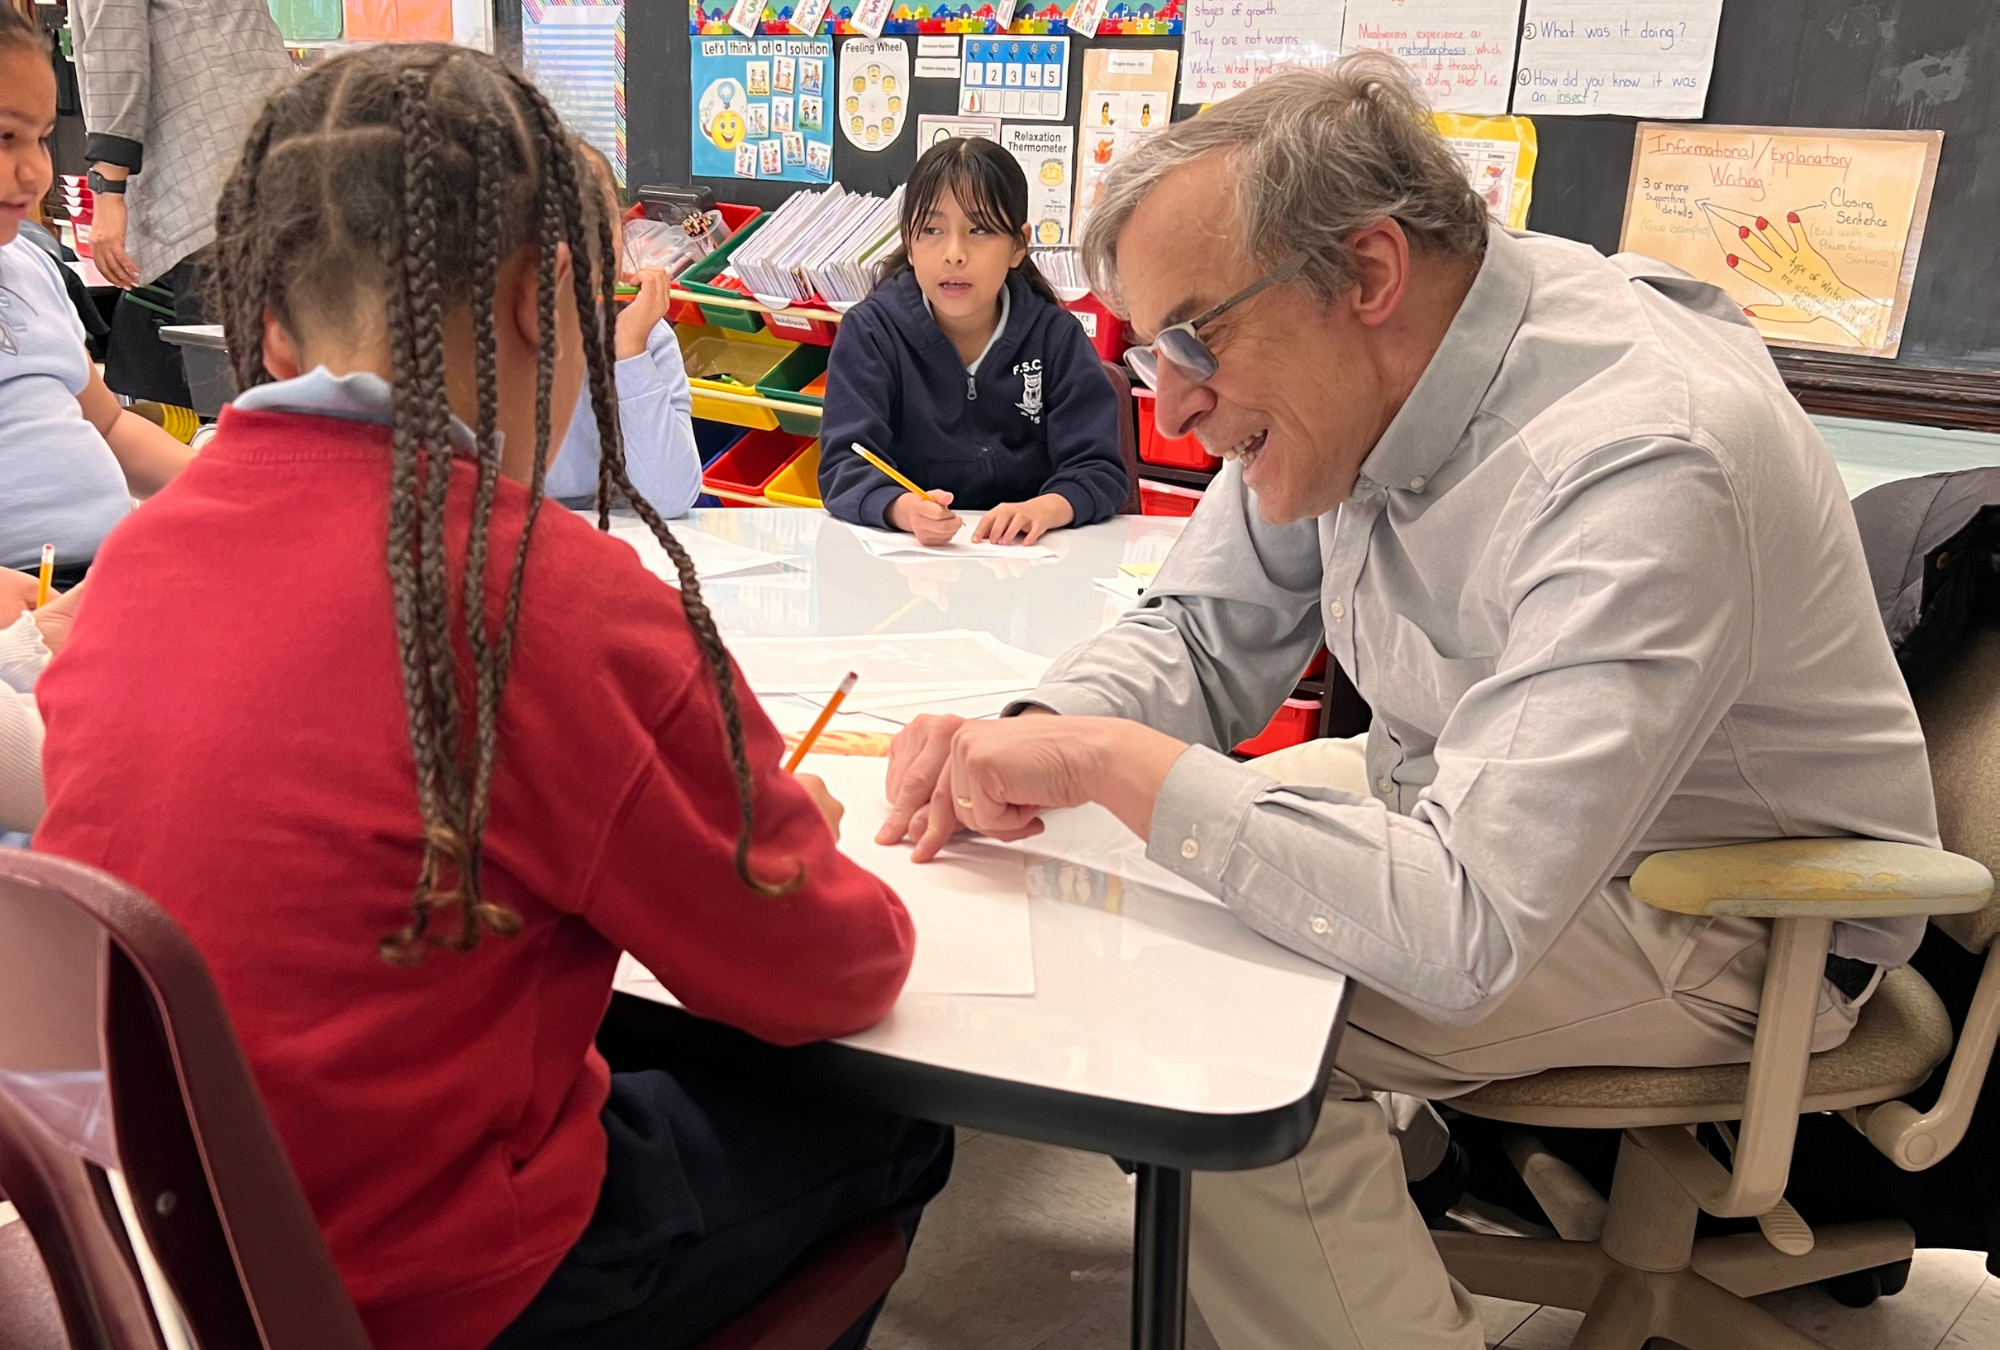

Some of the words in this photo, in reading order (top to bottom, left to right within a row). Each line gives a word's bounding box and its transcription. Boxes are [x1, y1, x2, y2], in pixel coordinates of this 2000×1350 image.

[1194, 1, 1224, 28] stages
[1232, 2, 1243, 16] of
[1358, 23, 1407, 39] Mealworms
[1416, 30, 1464, 50] experience
[1471, 30, 1481, 38] a
[1541, 20, 1575, 38] What
[1585, 27, 1610, 38] was
[1620, 20, 1630, 38] it
[704, 42, 724, 55] Let's
[730, 42, 753, 55] think
[762, 42, 771, 55] of
[775, 43, 782, 53] a
[790, 42, 829, 56] solution
[845, 42, 875, 55] Feeling
[877, 41, 902, 53] Wheel
[1190, 30, 1214, 59] They
[1222, 36, 1237, 46] are
[1245, 29, 1261, 44] not
[1190, 59, 1220, 74] Write:
[1224, 59, 1249, 74] What
[1433, 63, 1444, 80] go
[1448, 57, 1482, 81] through
[991, 69, 998, 82] 2
[1010, 70, 1017, 83] 3
[1030, 70, 1037, 83] 4
[1049, 70, 1055, 84] 5
[1425, 72, 1452, 96] during
[1534, 70, 1557, 87] How
[1563, 70, 1578, 87] did
[1585, 77, 1604, 97] you
[1613, 72, 1640, 88] know
[1653, 71, 1662, 87] it
[1672, 78, 1697, 88] was
[1196, 74, 1207, 88] do
[1211, 81, 1226, 100] you
[1232, 80, 1247, 88] see
[1531, 92, 1546, 103] an
[1014, 131, 1061, 143] Relaxation
[1008, 141, 1067, 153] Thermometer
[1642, 177, 1650, 189] 3
[1654, 181, 1663, 190] or
[1665, 183, 1690, 193] more
[1661, 203, 1693, 219] details
[1830, 187, 1875, 219] Closing
[1836, 211, 1889, 228] Sentence
[1838, 226, 1861, 238] with
[1867, 231, 1877, 239] a
[1789, 255, 1807, 276] type
[1809, 273, 1821, 282] of
